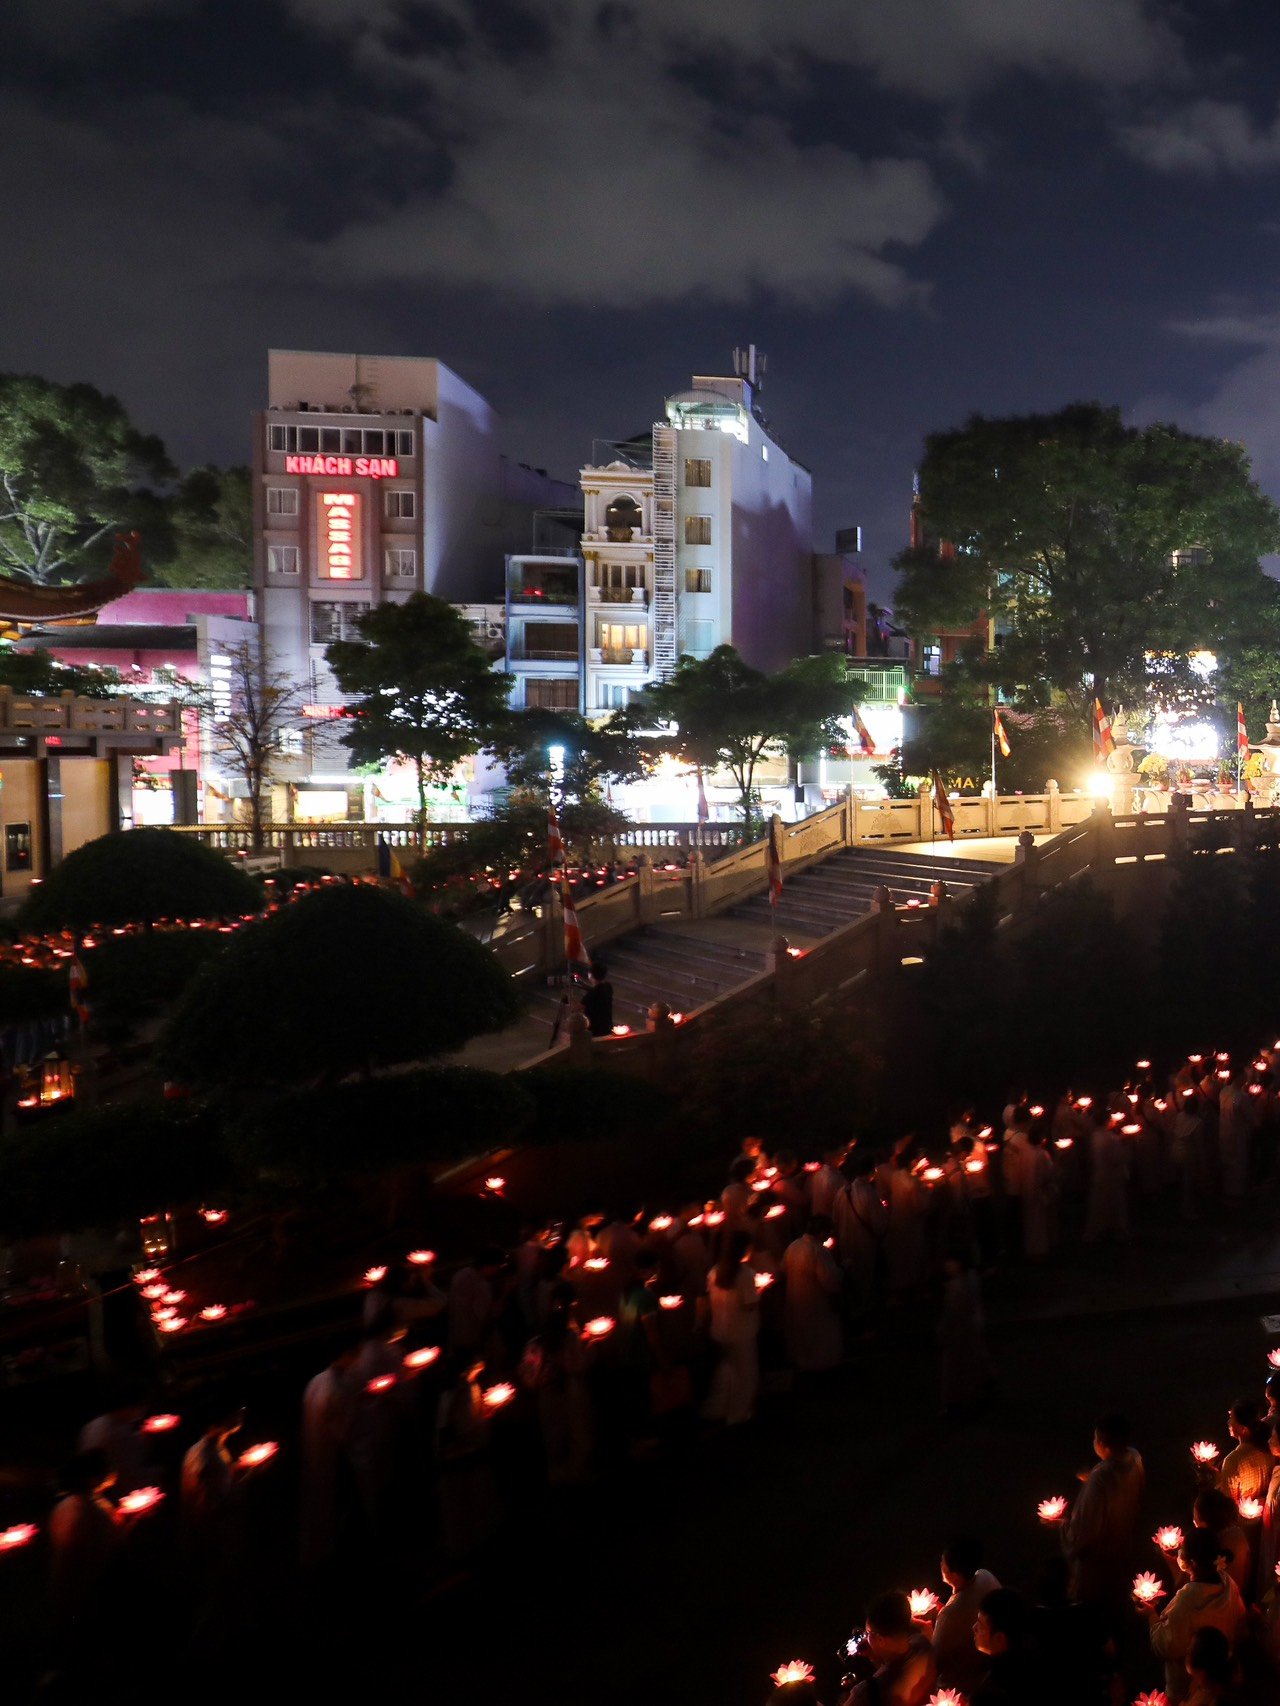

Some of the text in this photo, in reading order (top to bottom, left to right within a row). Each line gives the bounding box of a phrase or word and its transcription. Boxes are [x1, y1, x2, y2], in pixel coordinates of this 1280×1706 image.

[285, 453, 398, 480] KHÁCH SẠN
[323, 493, 356, 579] MASSAGE
